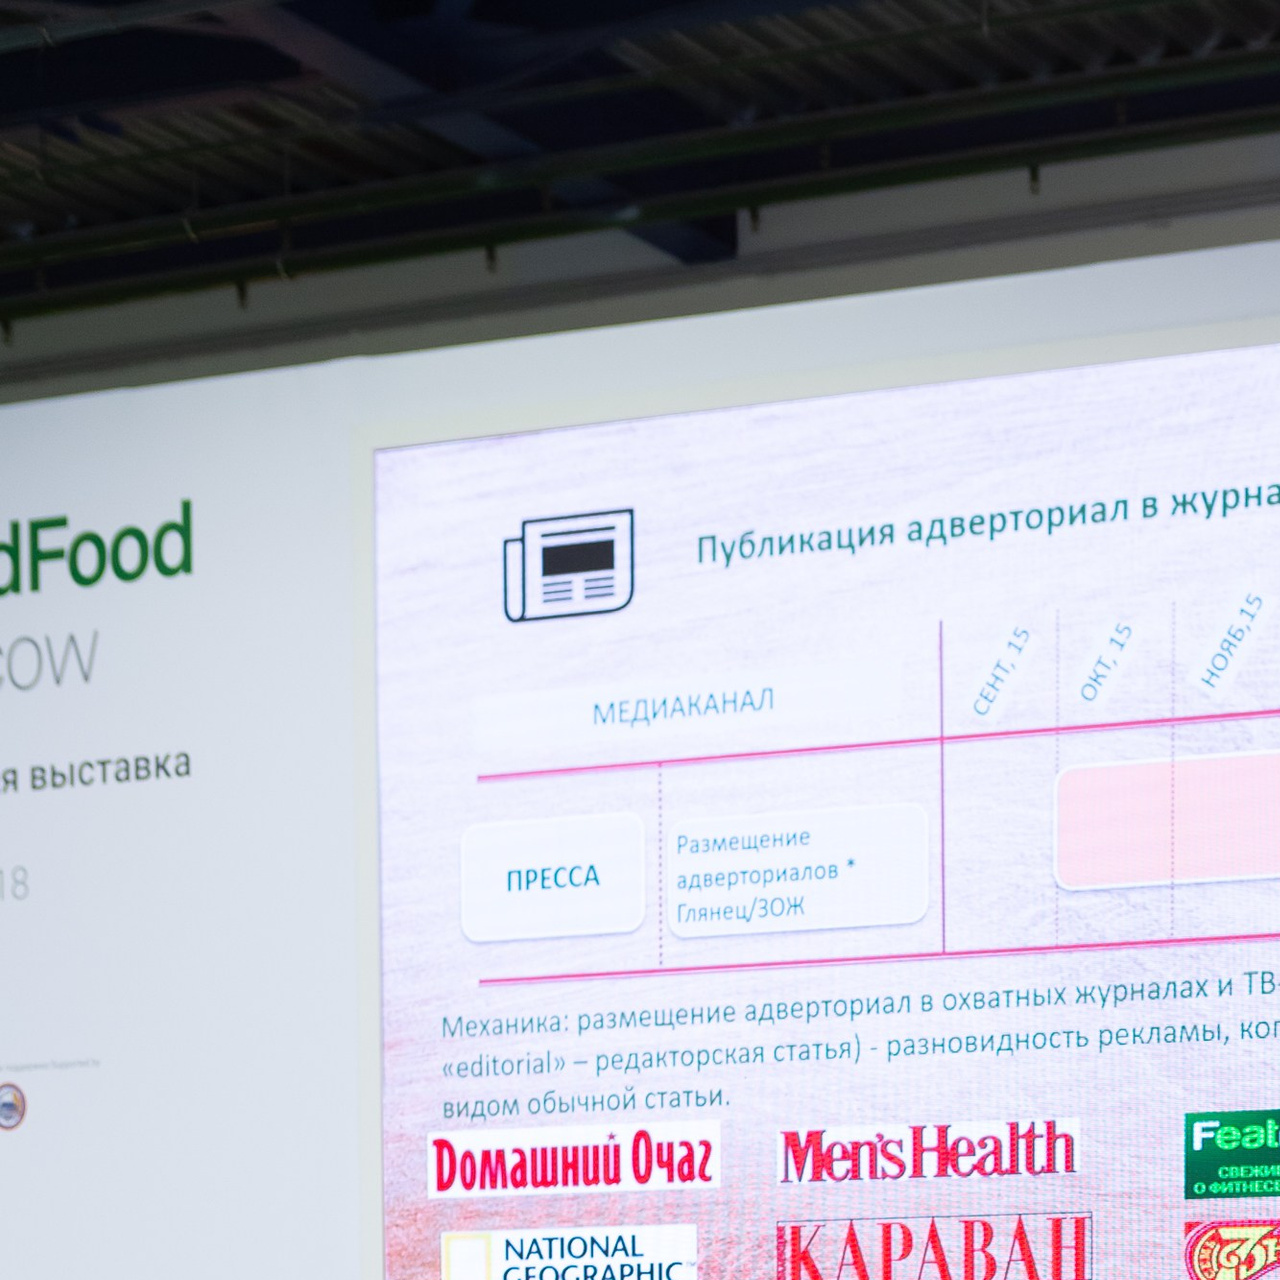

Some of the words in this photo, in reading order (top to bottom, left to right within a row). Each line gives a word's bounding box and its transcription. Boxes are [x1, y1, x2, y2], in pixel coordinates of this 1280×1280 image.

[697, 523, 895, 568] Публикация
[907, 498, 1129, 547] адверториал
[1142, 496, 1158, 519] в
[973, 658, 1016, 716] СЕНТ,
[1007, 626, 1030, 654] 15
[1080, 655, 1118, 702] ОКТ,
[1109, 622, 1132, 651] 15
[593, 687, 775, 728] МЕДИАКАНАЛ
[30, 752, 190, 791] выставка
[676, 830, 811, 855] Размещение
[506, 864, 601, 892] ПРЕССА
[676, 863, 839, 891] адверториалов
[676, 895, 805, 924] Глянец/ЗОЖ
[442, 1012, 569, 1038] Механика:
[577, 1003, 736, 1036] размещение
[744, 993, 911, 1026] адверториал
[921, 992, 933, 1013] в
[942, 985, 1067, 1012] охватных
[1075, 977, 1208, 1009] журналах
[1217, 977, 1233, 998] и
[596, 1044, 765, 1077] редакторская
[773, 1033, 861, 1065] статья)
[887, 1028, 1090, 1062] разновидность
[1099, 1020, 1229, 1053] рекламы,
[443, 1096, 520, 1123] видом
[527, 1085, 637, 1115] обычной
[645, 1087, 731, 1110] статьи.
[632, 1129, 713, 1185] Очаг
[1193, 1181, 1206, 1195] О
[505, 1234, 645, 1261] NATIONAL
